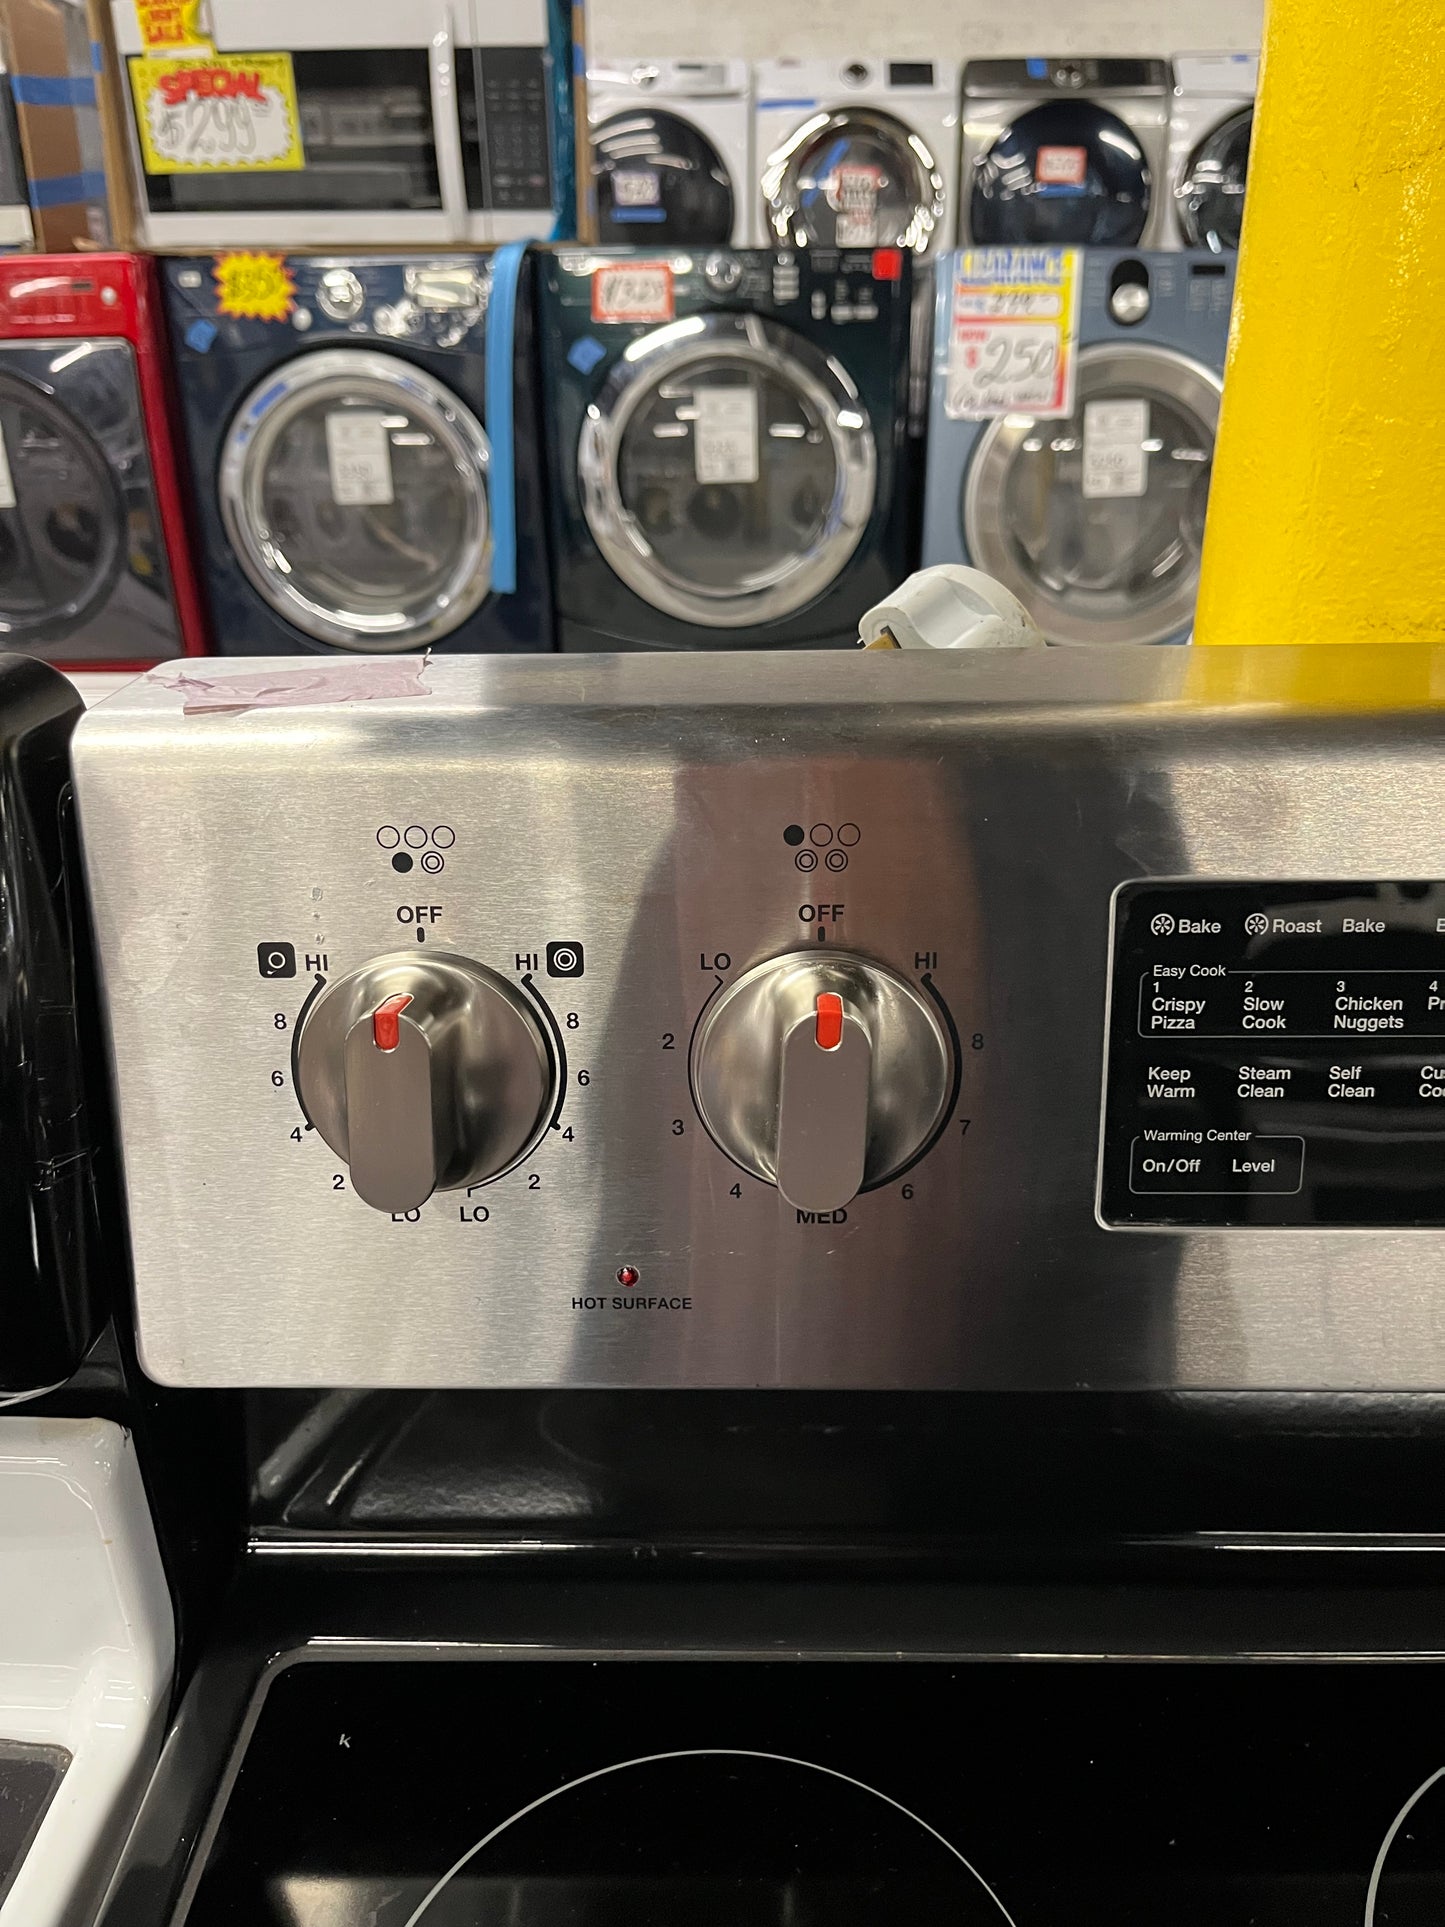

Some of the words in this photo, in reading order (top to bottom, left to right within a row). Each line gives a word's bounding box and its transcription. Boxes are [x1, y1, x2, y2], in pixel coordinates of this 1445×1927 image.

[973, 337, 1056, 388] 250
[397, 906, 442, 923] OFF
[799, 905, 844, 922] OFF
[1179, 919, 1221, 933] Bake
[1273, 919, 1322, 932] Roast
[1343, 918, 1385, 932] Bake
[305, 955, 328, 971] HI
[516, 954, 538, 970] HI
[701, 953, 731, 970] LO
[915, 952, 937, 969] HI
[1154, 965, 1186, 979] Easy
[1190, 965, 1225, 976] Cook
[1153, 982, 1159, 992] 1
[1245, 981, 1253, 992] 2
[1337, 981, 1345, 992] 3
[1429, 981, 1437, 991] 4
[1152, 997, 1205, 1014] Crispy
[1244, 997, 1284, 1010] Slow
[1336, 997, 1403, 1010] Chicken
[275, 1013, 286, 1029] 8
[567, 1013, 579, 1029] 8
[1152, 1016, 1195, 1029] Pizza
[1243, 1015, 1286, 1028] Cook
[1334, 1015, 1403, 1031] Nuggets
[663, 1033, 674, 1049] 2
[972, 1034, 984, 1050] 8
[272, 1071, 283, 1087] 6
[578, 1070, 590, 1086] 6
[1149, 1067, 1190, 1083] Keep
[1239, 1066, 1290, 1080] Steam
[1329, 1066, 1362, 1079] Self
[1147, 1082, 1195, 1097] Warm
[1238, 1084, 1284, 1097] Clean
[1328, 1084, 1374, 1097] Clean
[290, 1127, 302, 1142] 4
[563, 1127, 574, 1142] 4
[672, 1119, 684, 1135] 3
[960, 1120, 971, 1135] 7
[1144, 1130, 1202, 1143] Warming
[1207, 1130, 1252, 1141] Center
[1143, 1159, 1201, 1172] On/Off
[1233, 1159, 1274, 1172] Level
[333, 1175, 345, 1189] 2
[529, 1174, 540, 1189] 2
[730, 1183, 742, 1198] 4
[902, 1184, 913, 1199] 6
[460, 1206, 489, 1222] LO
[796, 1208, 847, 1224] MED
[573, 1298, 607, 1309] HOT
[613, 1298, 691, 1309] SURFACE
